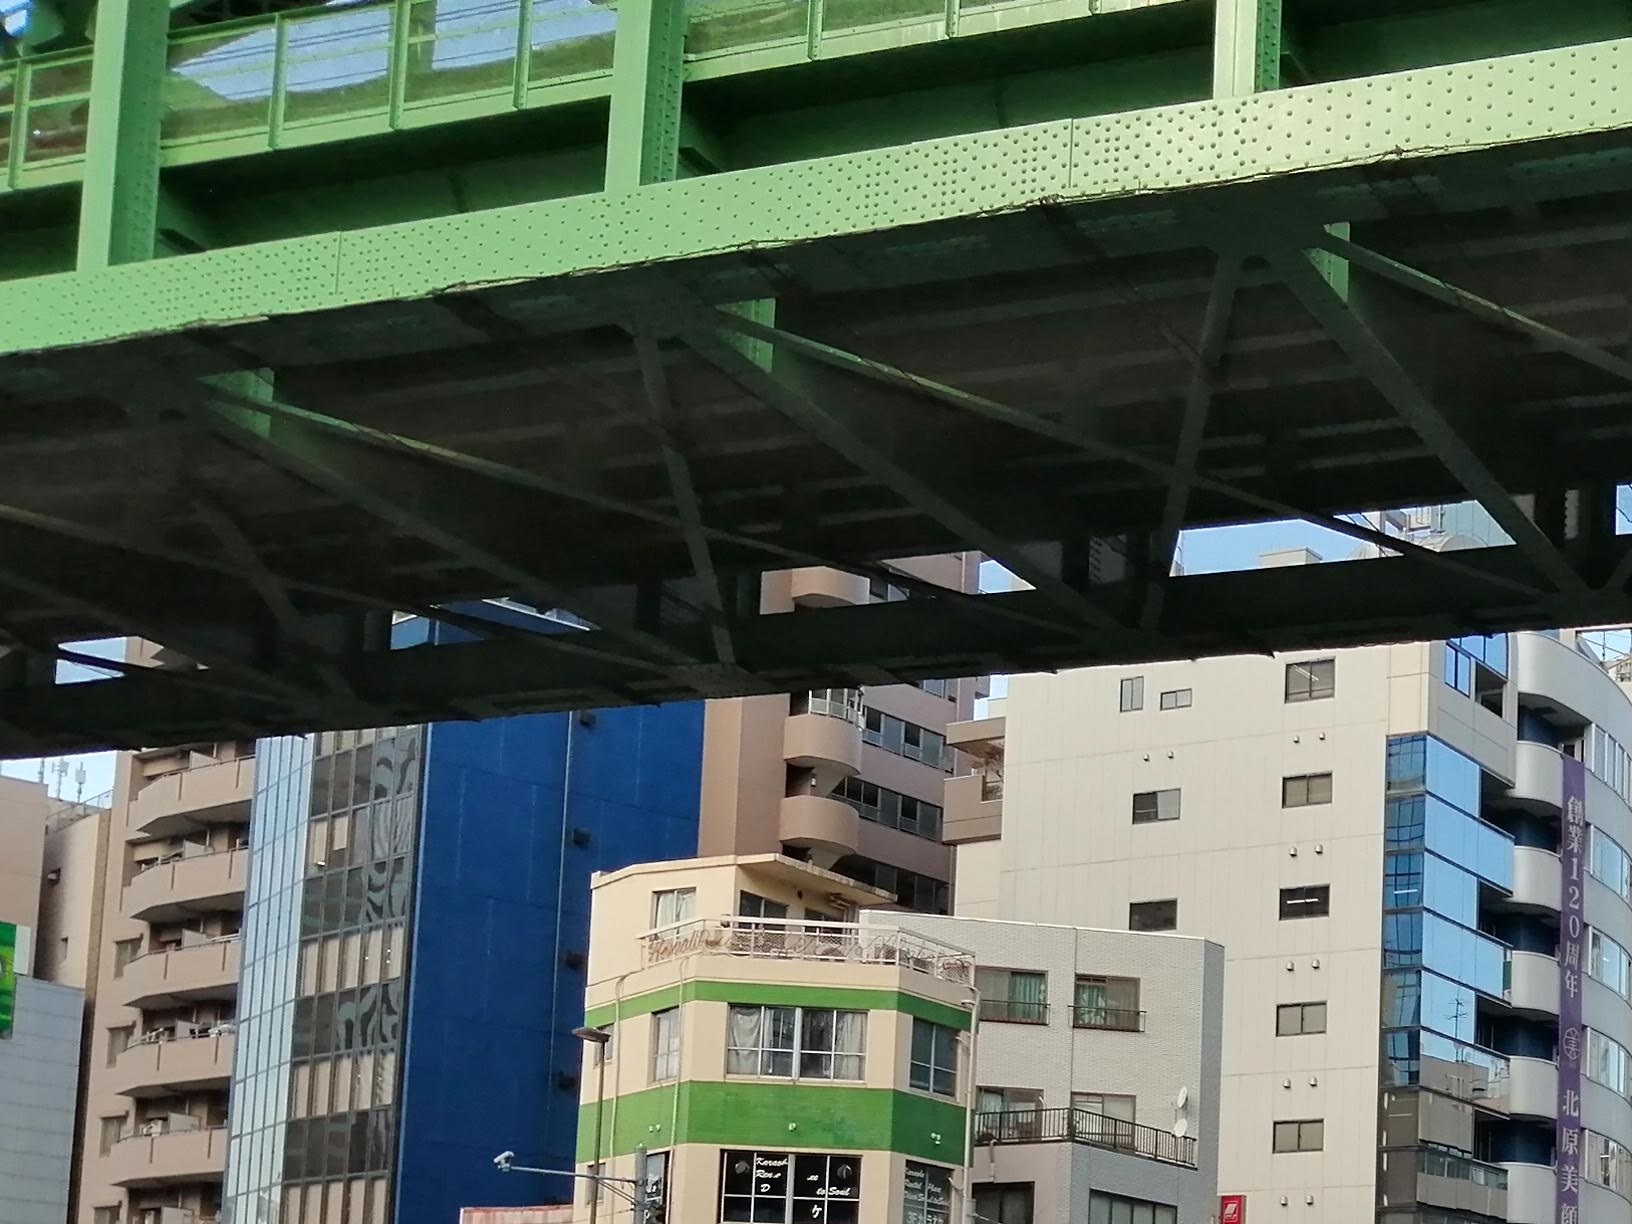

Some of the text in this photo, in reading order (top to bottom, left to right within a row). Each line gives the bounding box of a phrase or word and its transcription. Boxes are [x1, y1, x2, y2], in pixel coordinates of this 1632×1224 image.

[1565, 796, 1584, 998] 創業120周年
[829, 1187, 850, 1196] Soul
